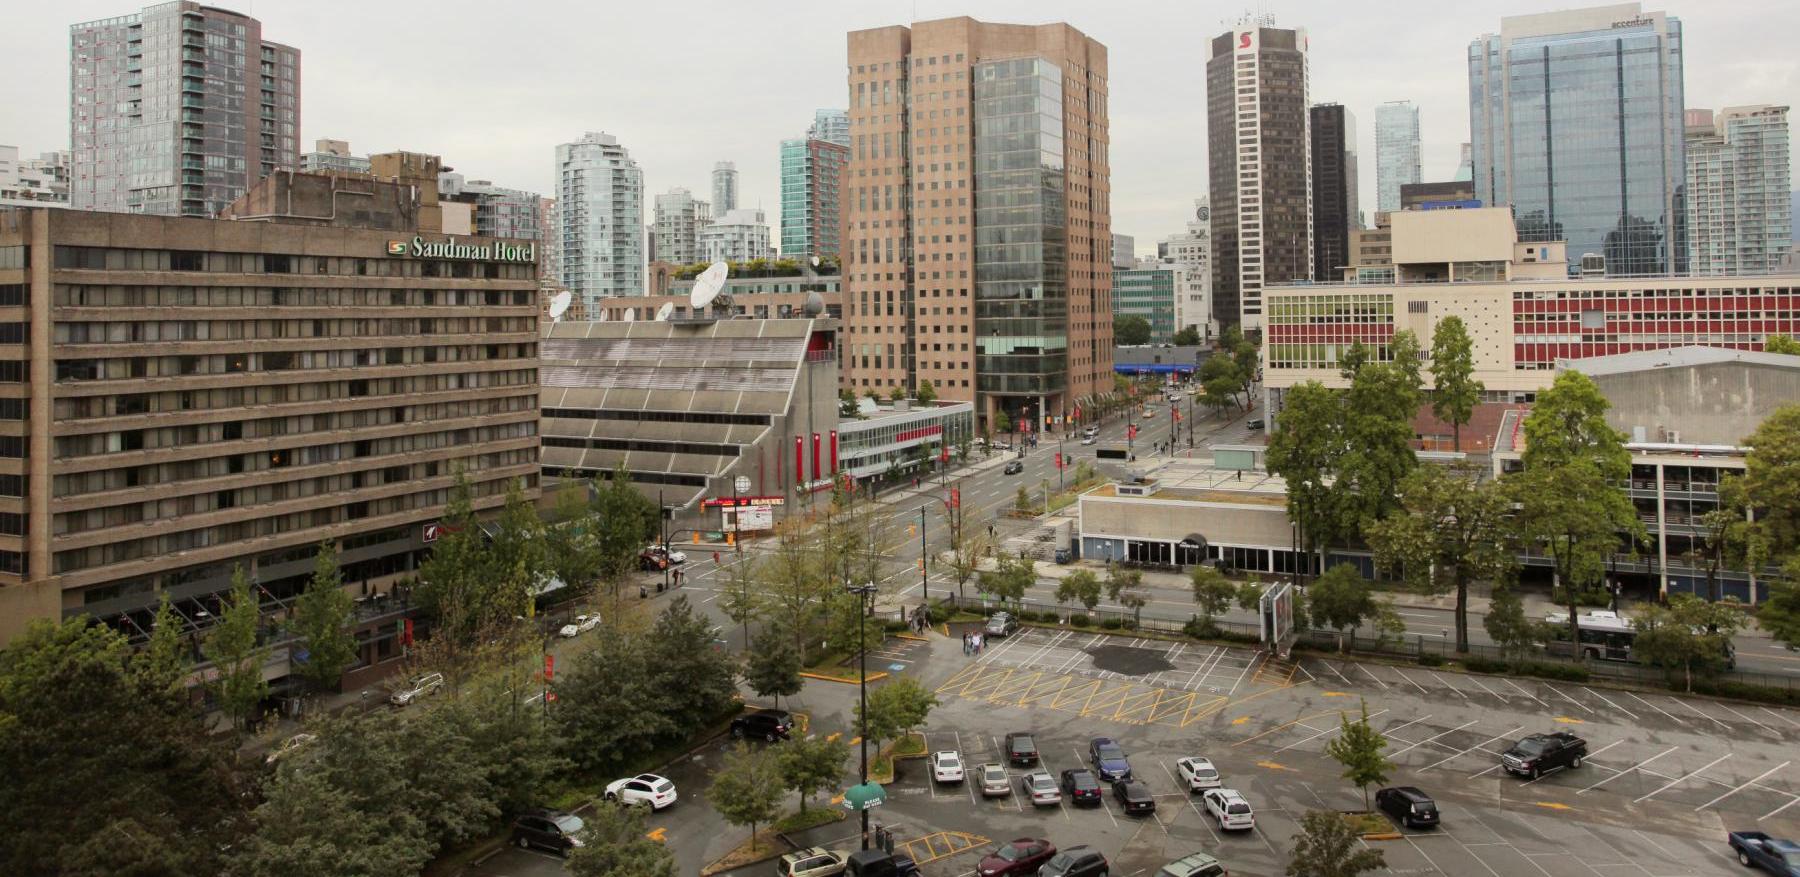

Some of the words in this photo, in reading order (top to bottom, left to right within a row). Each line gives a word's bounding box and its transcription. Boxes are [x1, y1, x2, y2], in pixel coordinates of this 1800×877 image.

[1611, 17, 1654, 29] accenture
[412, 235, 490, 261] Sandman
[494, 241, 535, 263] Hotel
